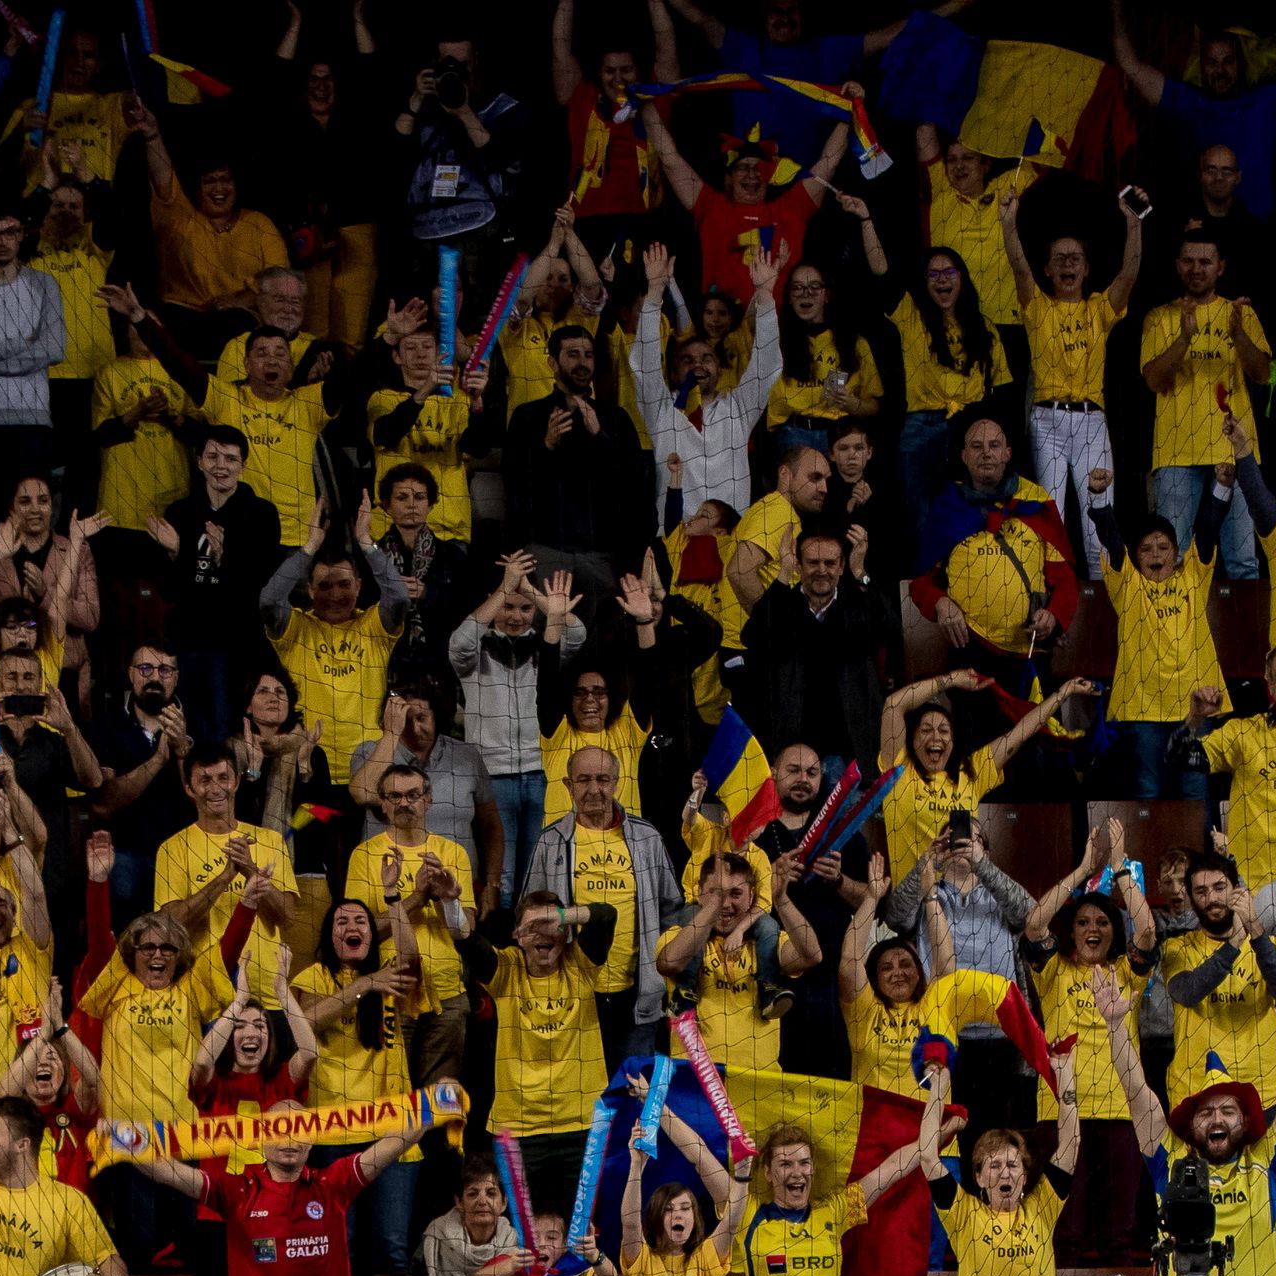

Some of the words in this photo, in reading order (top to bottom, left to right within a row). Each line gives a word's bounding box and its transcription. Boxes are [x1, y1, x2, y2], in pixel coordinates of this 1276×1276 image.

[587, 879, 625, 890] DOÏNA
[254, 1100, 398, 1142] ROMANIA
[791, 1255, 835, 1271] BRD
